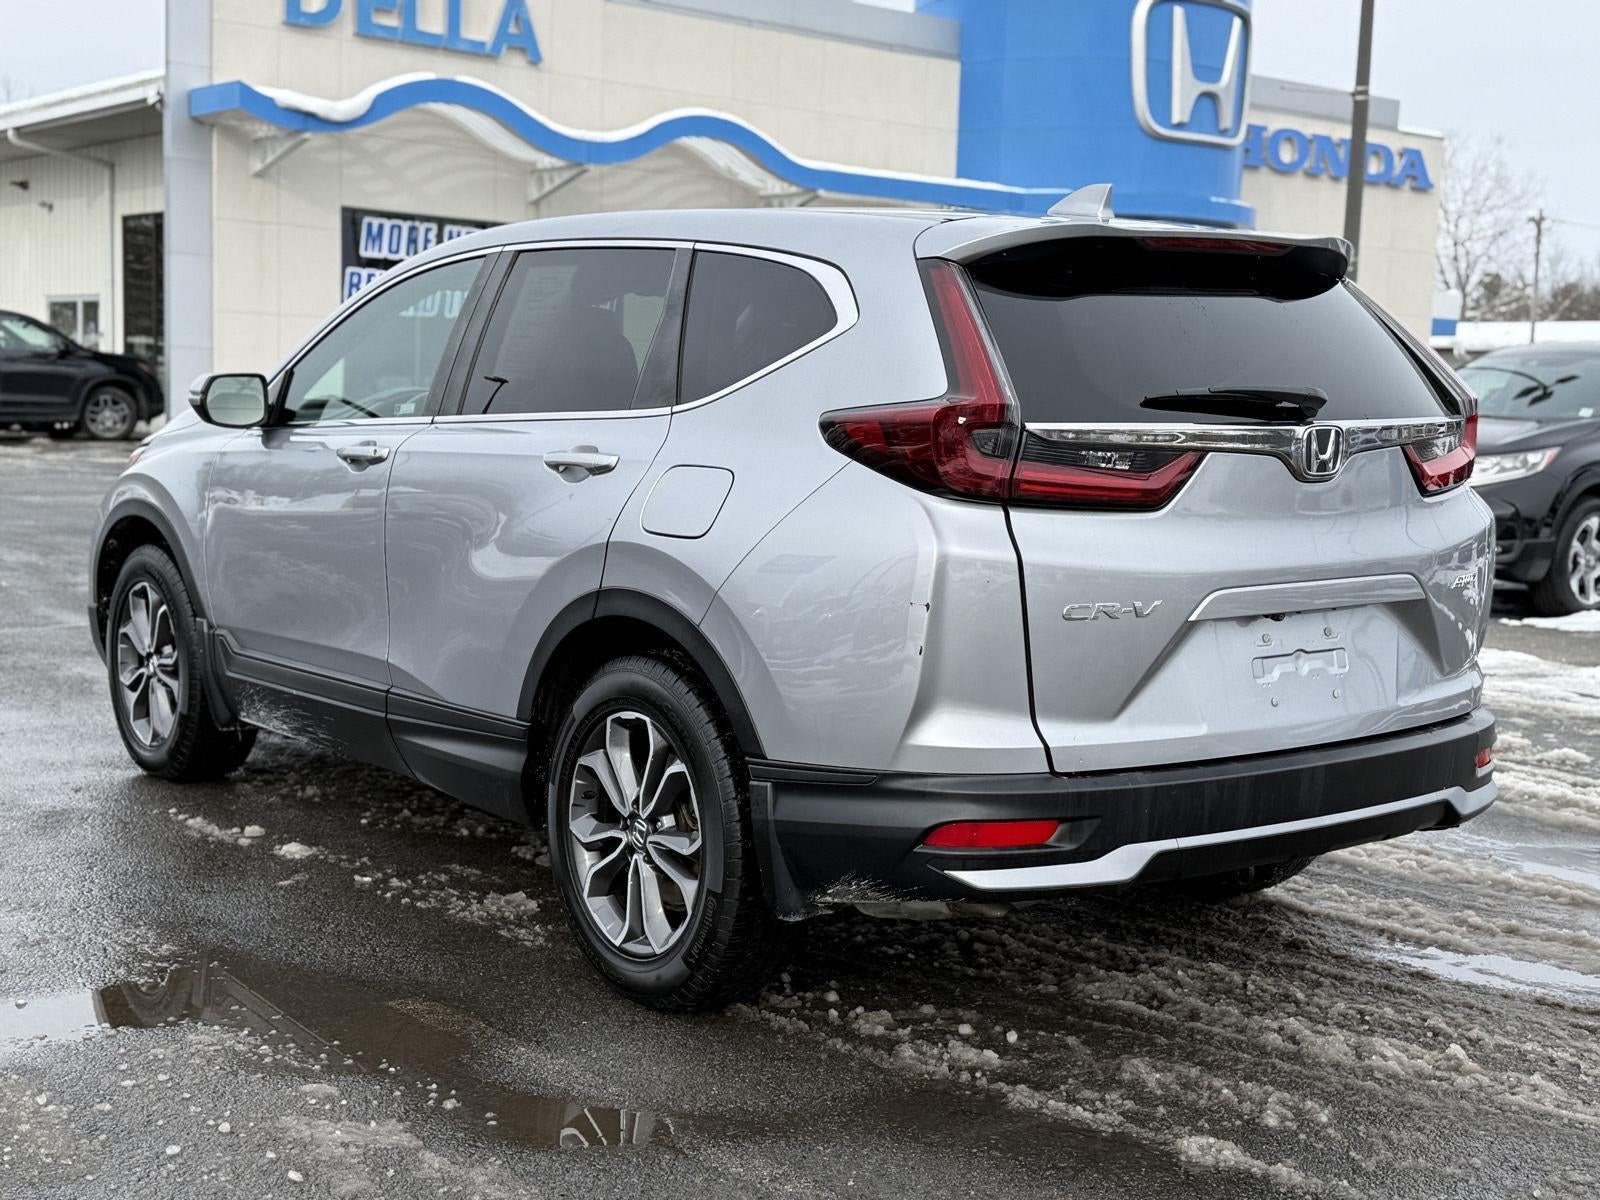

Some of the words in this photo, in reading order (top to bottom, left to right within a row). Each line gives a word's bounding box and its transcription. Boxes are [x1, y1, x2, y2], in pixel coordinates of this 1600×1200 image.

[282, 0, 543, 64] DELLA
[364, 220, 434, 257] MORE
[1062, 600, 1163, 621] CR-V
